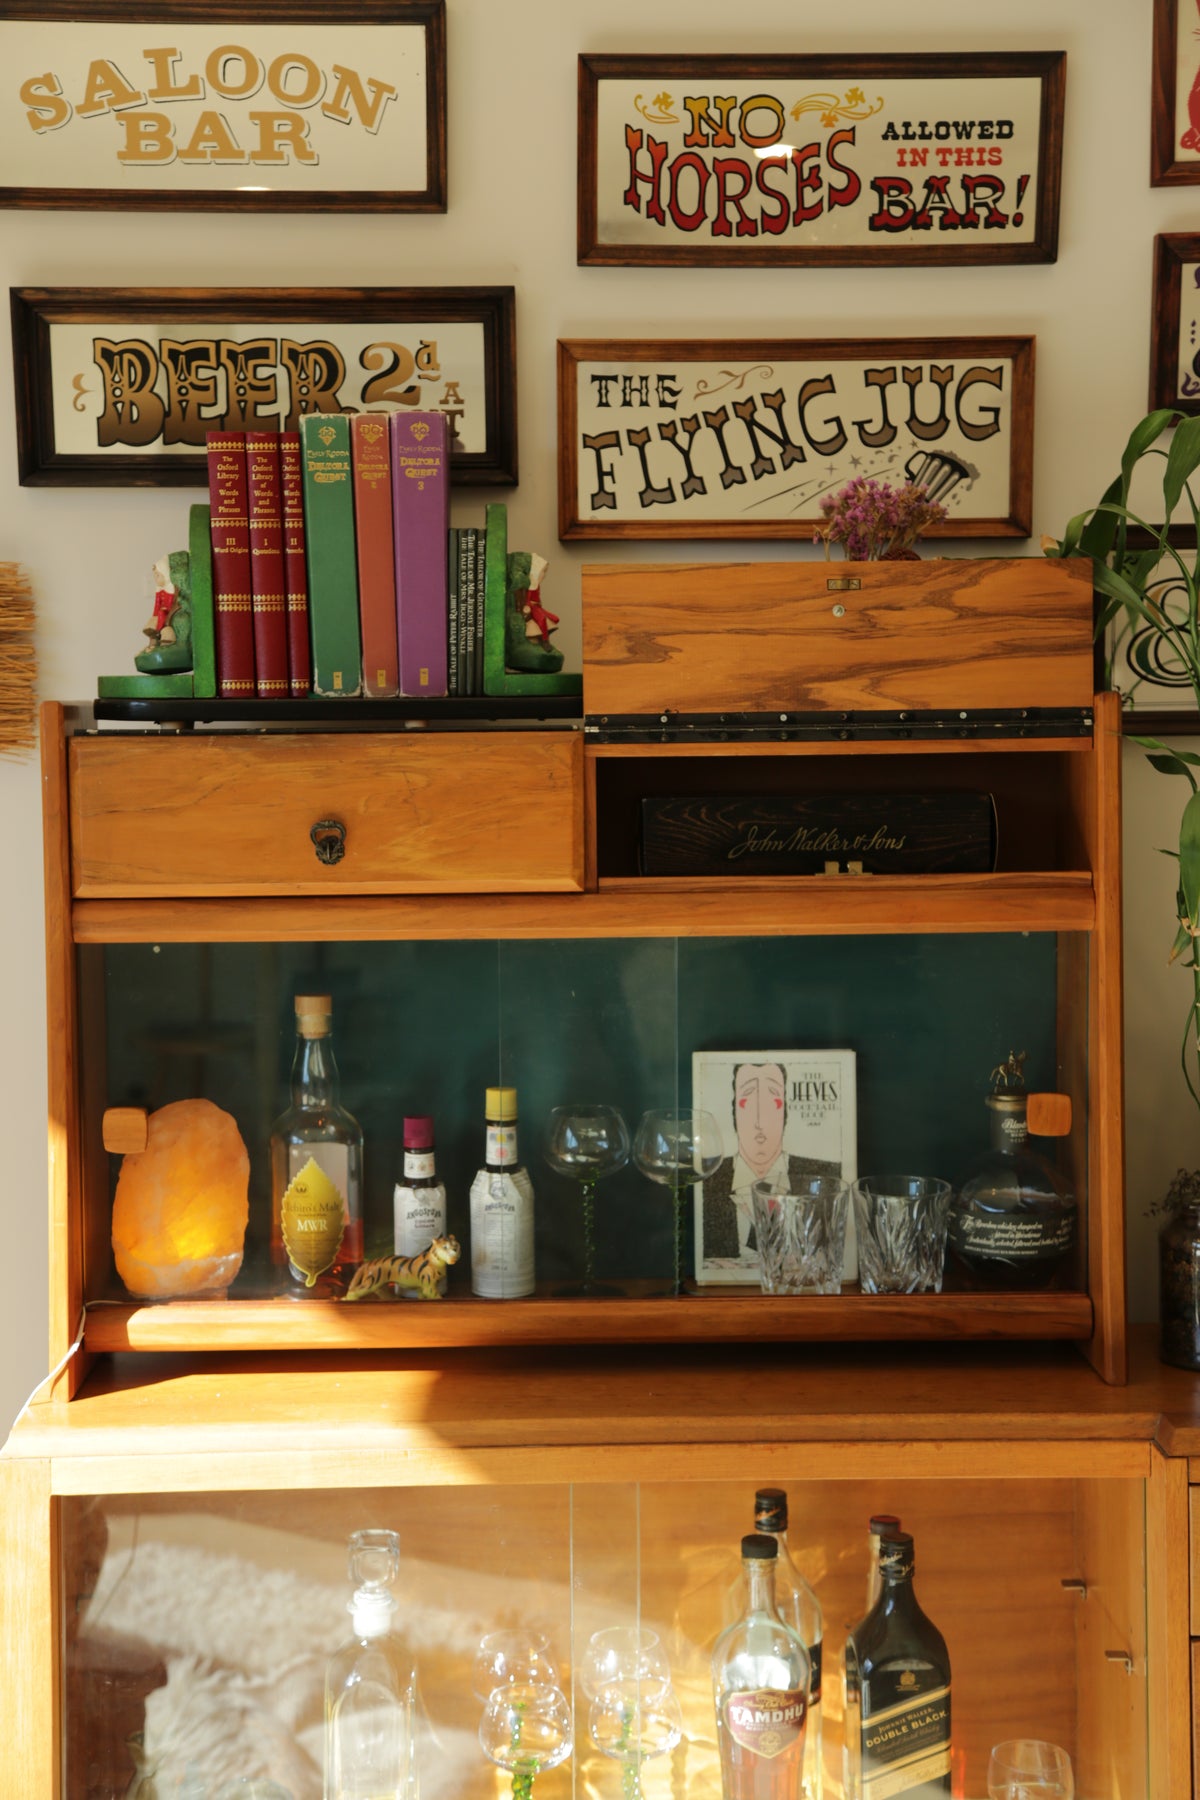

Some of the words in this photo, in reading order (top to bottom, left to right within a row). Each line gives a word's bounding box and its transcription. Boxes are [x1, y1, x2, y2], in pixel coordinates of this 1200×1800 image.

[19, 45, 398, 135] SALOON
[116, 110, 320, 166] BAR
[683, 94, 785, 149] NO
[881, 119, 1014, 141] ALLOWED
[896, 147, 931, 167] IN
[935, 146, 1003, 166] THIS
[623, 124, 863, 237] HORSES
[868, 173, 1031, 233] BAR!
[93, 338, 358, 447] BEER
[439, 382, 464, 404] A
[590, 374, 684, 411] THE
[582, 373, 849, 512] FLYING
[852, 364, 1004, 448] JUG
[217, 472, 240, 480] Library
[252, 473, 274, 481] Library
[418, 481, 424, 490] 3
[727, 825, 784, 859] John
[787, 826, 853, 851] Walker
[863, 825, 907, 850] Sons
[789, 1081, 838, 1102] JEEVES
[297, 1219, 328, 1232] MWR
[730, 1703, 804, 1726] TAMDHU
[865, 1725, 909, 1748] DOUBLE
[911, 1710, 948, 1730] BLACK
